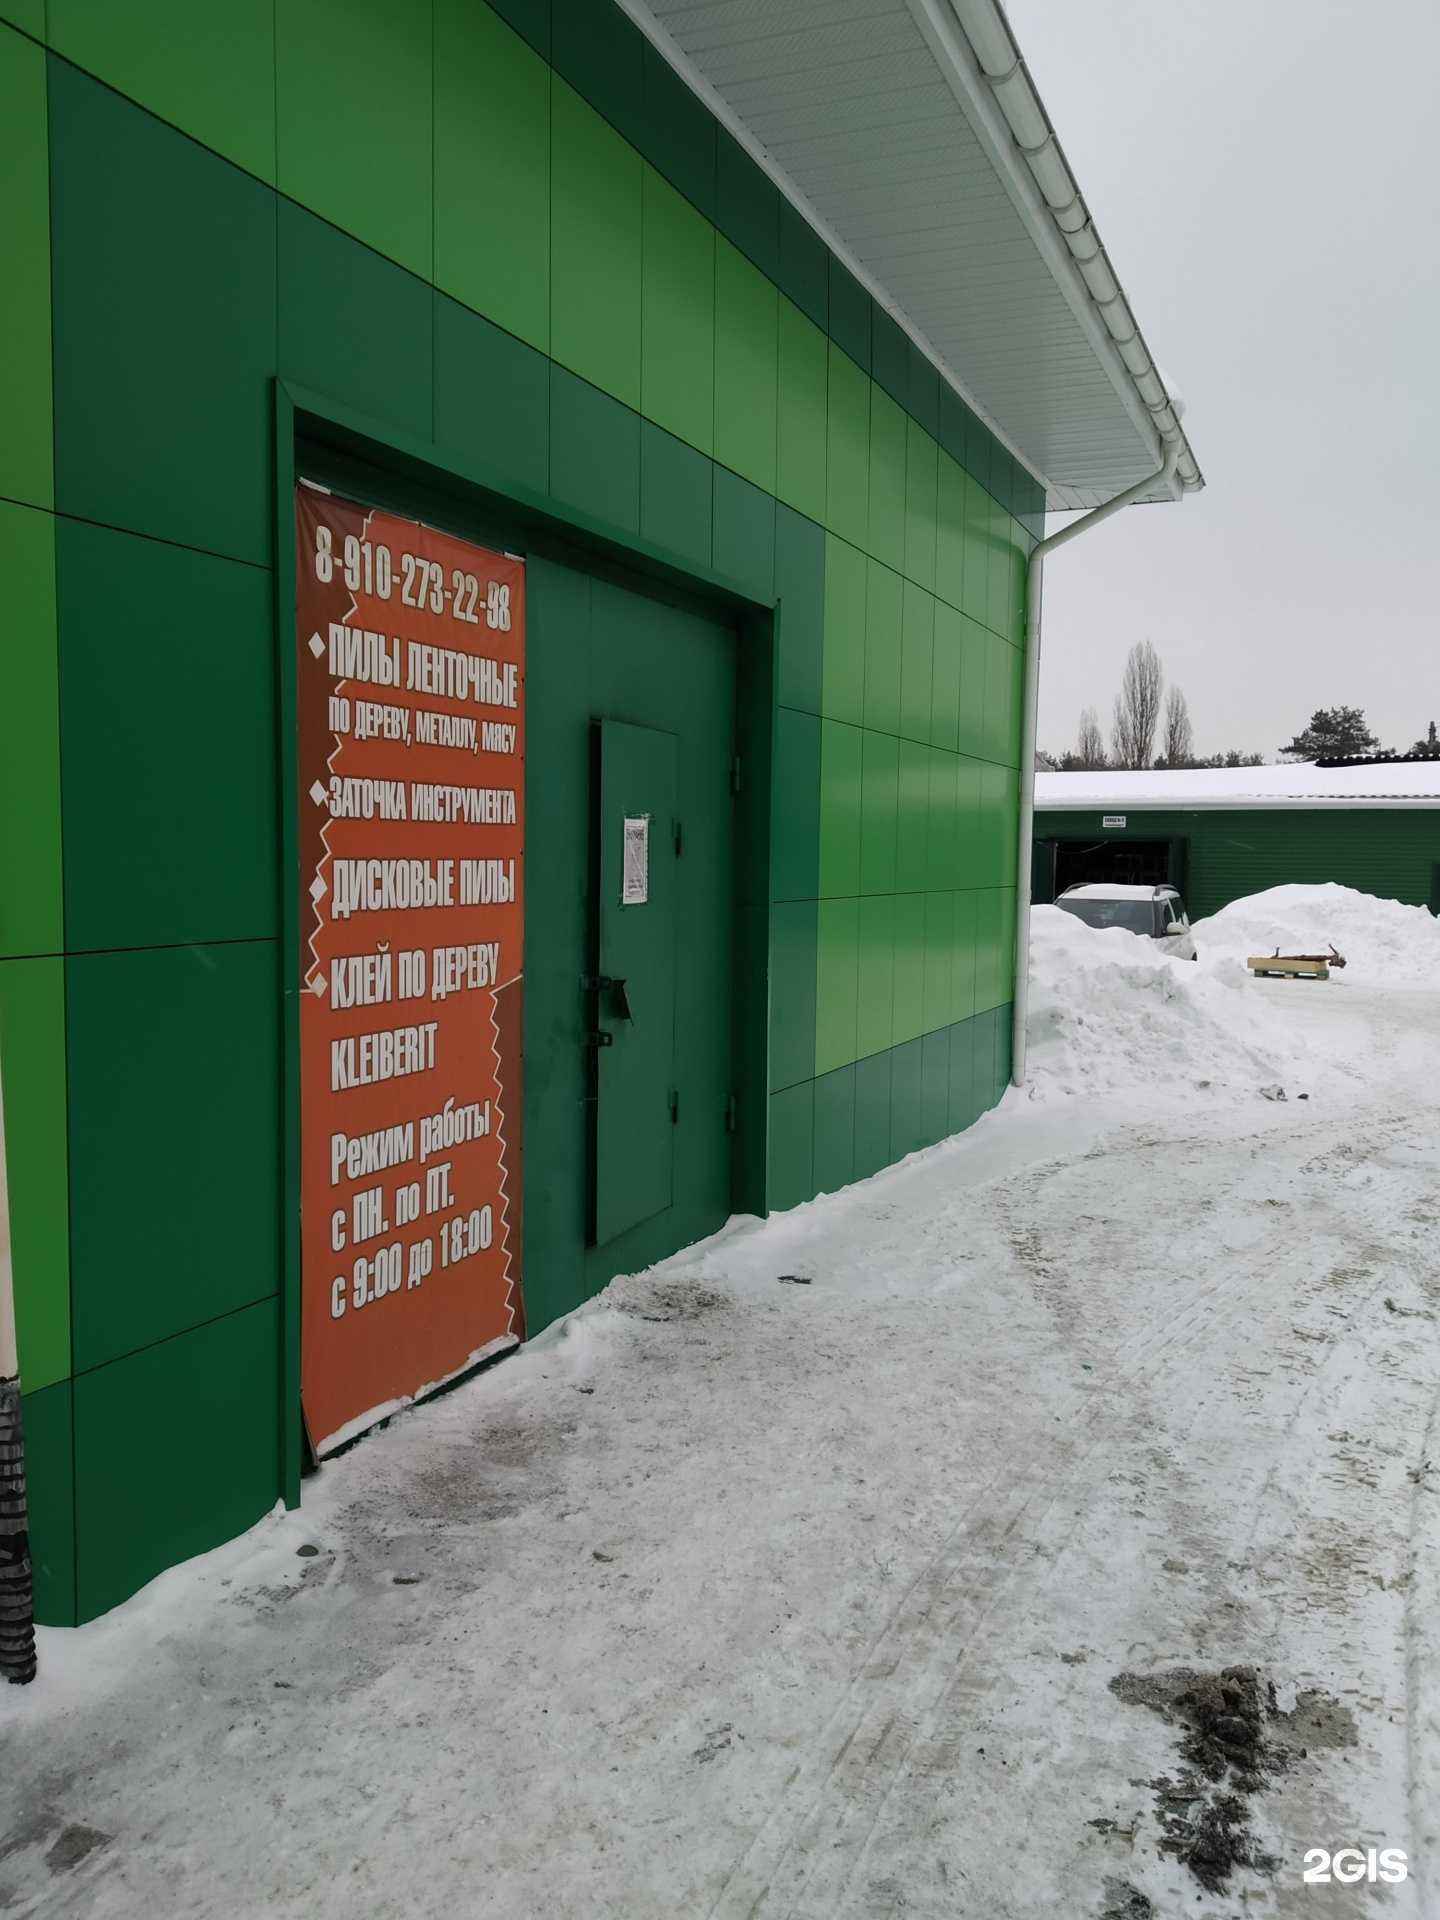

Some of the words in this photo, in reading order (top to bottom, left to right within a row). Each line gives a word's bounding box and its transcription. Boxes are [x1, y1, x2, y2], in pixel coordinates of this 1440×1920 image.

[314, 525, 512, 632] 8-910-273-22-98
[328, 622, 400, 688] ПИЛЫ
[406, 641, 518, 708] ЛЕНТОЧНЫЕ
[328, 695, 350, 733] ПО
[354, 701, 411, 747] ДЕРЕВУ,
[415, 714, 479, 755] МЕТАЛЛУ,
[481, 720, 517, 755] МЯСУ
[329, 775, 407, 820] ЗАТОЧКА
[411, 782, 516, 825] ИНСТРУМЕНТА
[331, 858, 454, 919] ДИСКОВЫЕ
[459, 857, 516, 906] ПИЛЫ
[331, 942, 392, 1010] КЛЕЙ
[398, 949, 426, 1000] ПО
[431, 943, 499, 1001] ДЕРЕВУ
[331, 1022, 438, 1092] KLEIBERIT
[331, 1121, 414, 1186] Режим
[419, 1095, 491, 1164] работы
[332, 1208, 348, 1253] с
[352, 1187, 389, 1243] ПН.
[395, 1181, 420, 1227] по
[425, 1162, 455, 1215] ПТ.
[331, 1275, 346, 1320] с
[352, 1242, 403, 1308] 9:00
[407, 1238, 433, 1290] до
[439, 1204, 493, 1267] 18:00
